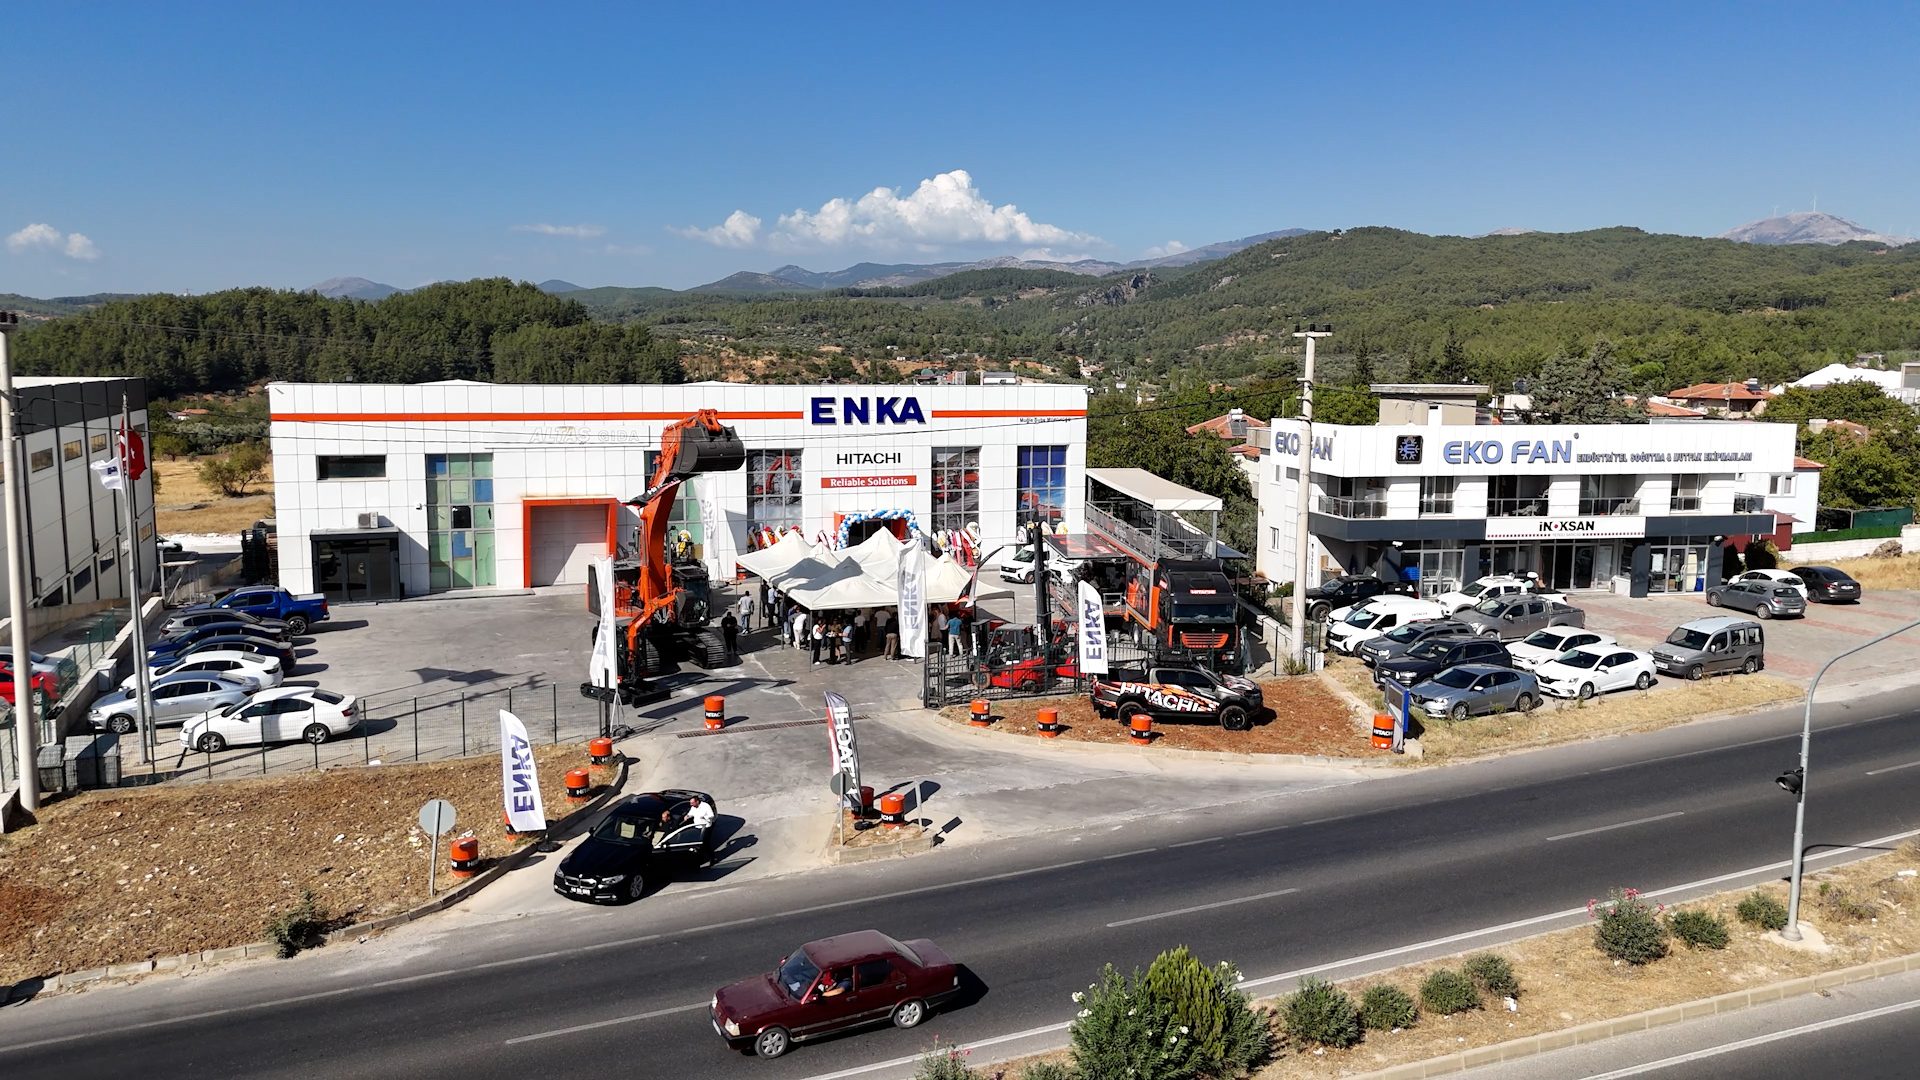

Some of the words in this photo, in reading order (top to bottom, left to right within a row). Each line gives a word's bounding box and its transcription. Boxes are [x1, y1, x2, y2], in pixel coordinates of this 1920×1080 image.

[811, 397, 927, 425] ENKA
[1275, 431, 1301, 456] EKO
[1443, 440, 1503, 464] EKO
[1511, 440, 1572, 464] FAN
[836, 452, 901, 465] HITACHI
[830, 478, 865, 487] Reliable
[867, 477, 909, 487] Solutions
